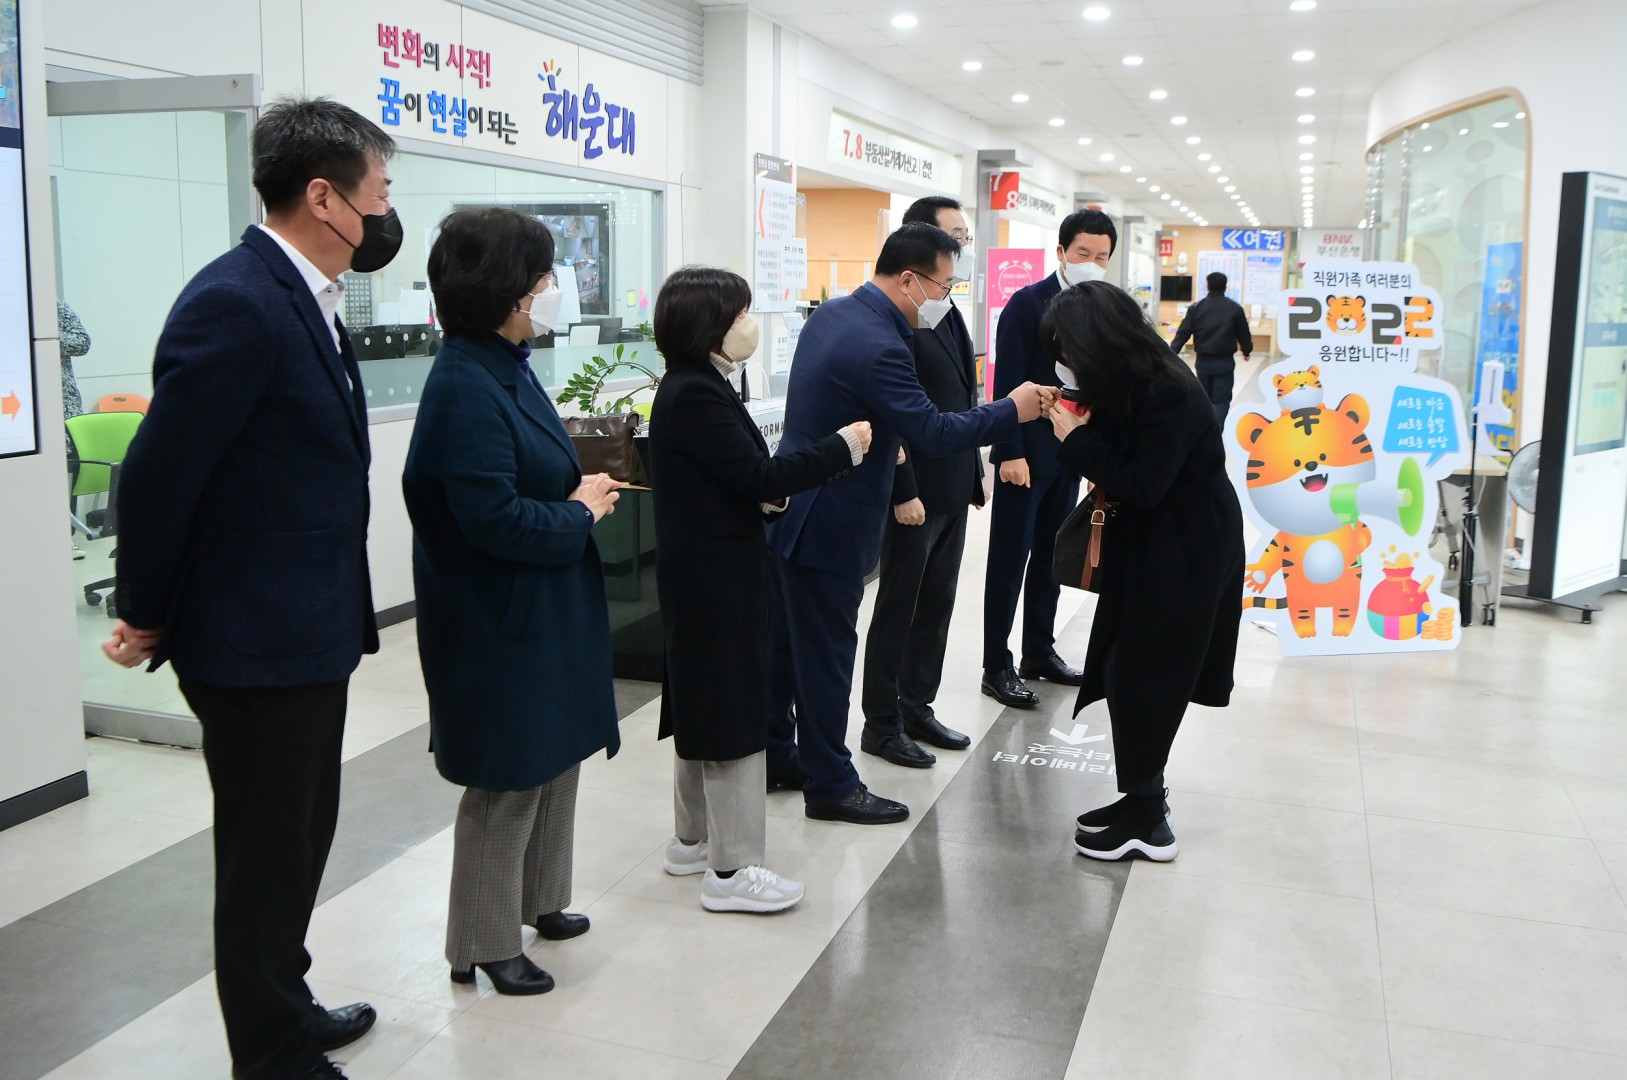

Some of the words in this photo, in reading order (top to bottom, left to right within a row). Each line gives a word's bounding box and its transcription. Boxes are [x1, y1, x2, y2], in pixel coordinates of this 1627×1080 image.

[378, 23, 440, 71] 변화의
[446, 44, 491, 88] 시작!
[378, 77, 422, 125] 꿈이
[427, 90, 483, 137] 현실이
[487, 110, 518, 145] 되는
[543, 74, 636, 158] 해운대
[843, 129, 863, 160] 7.8
[991, 171, 1004, 192] 7
[1006, 190, 1018, 210] 8
[1160, 243, 1172, 254] 11
[1322, 234, 1353, 245] BNK
[1316, 245, 1361, 258] 부산은행
[1313, 271, 1362, 288] 직원가족
[1365, 272, 1412, 289] 여러분의
[1397, 397, 1423, 410] 새로운
[1397, 418, 1423, 430] 새로운
[1397, 436, 1424, 448] 새로운
